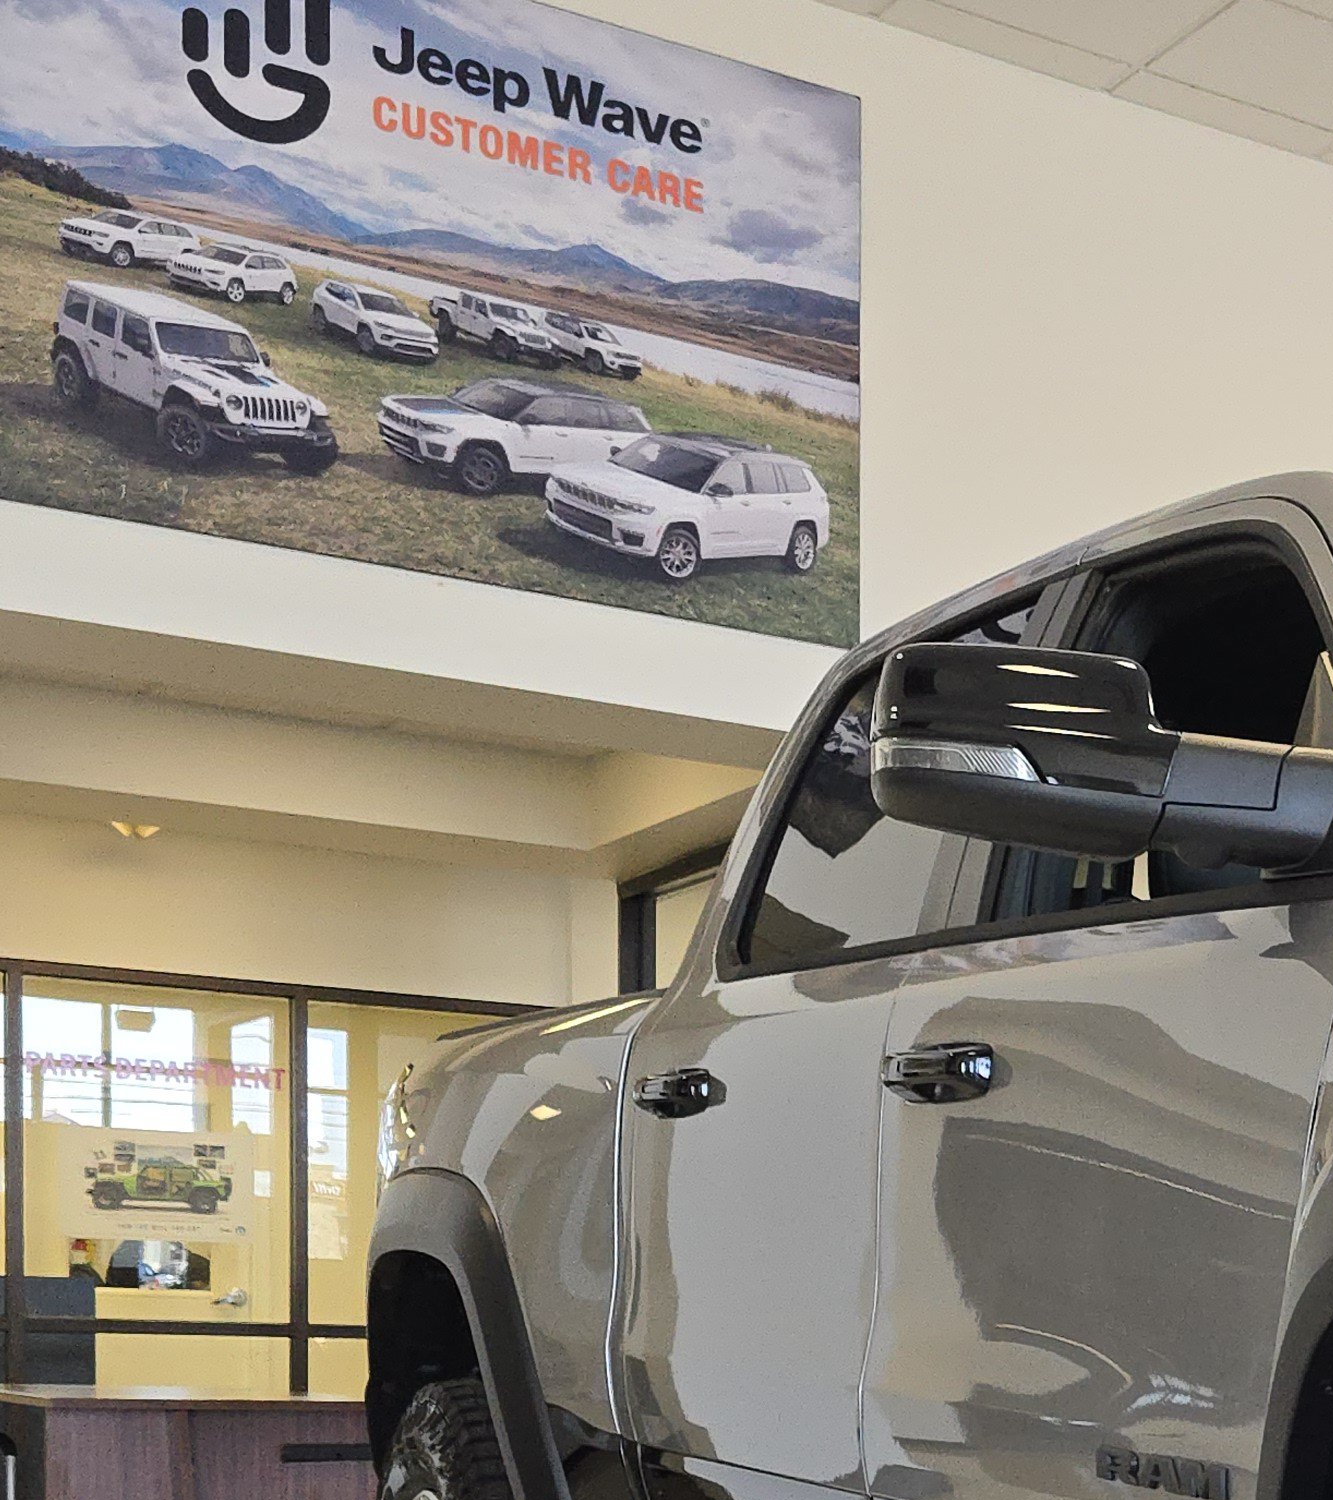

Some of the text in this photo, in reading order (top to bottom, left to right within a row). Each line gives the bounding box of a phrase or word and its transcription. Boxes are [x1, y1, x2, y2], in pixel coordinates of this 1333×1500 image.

[372, 26, 703, 154] Jeep Wave
[372, 96, 705, 215] CUSTOMER CARE
[25, 1051, 286, 1091] PARTS DEPARTMENT
